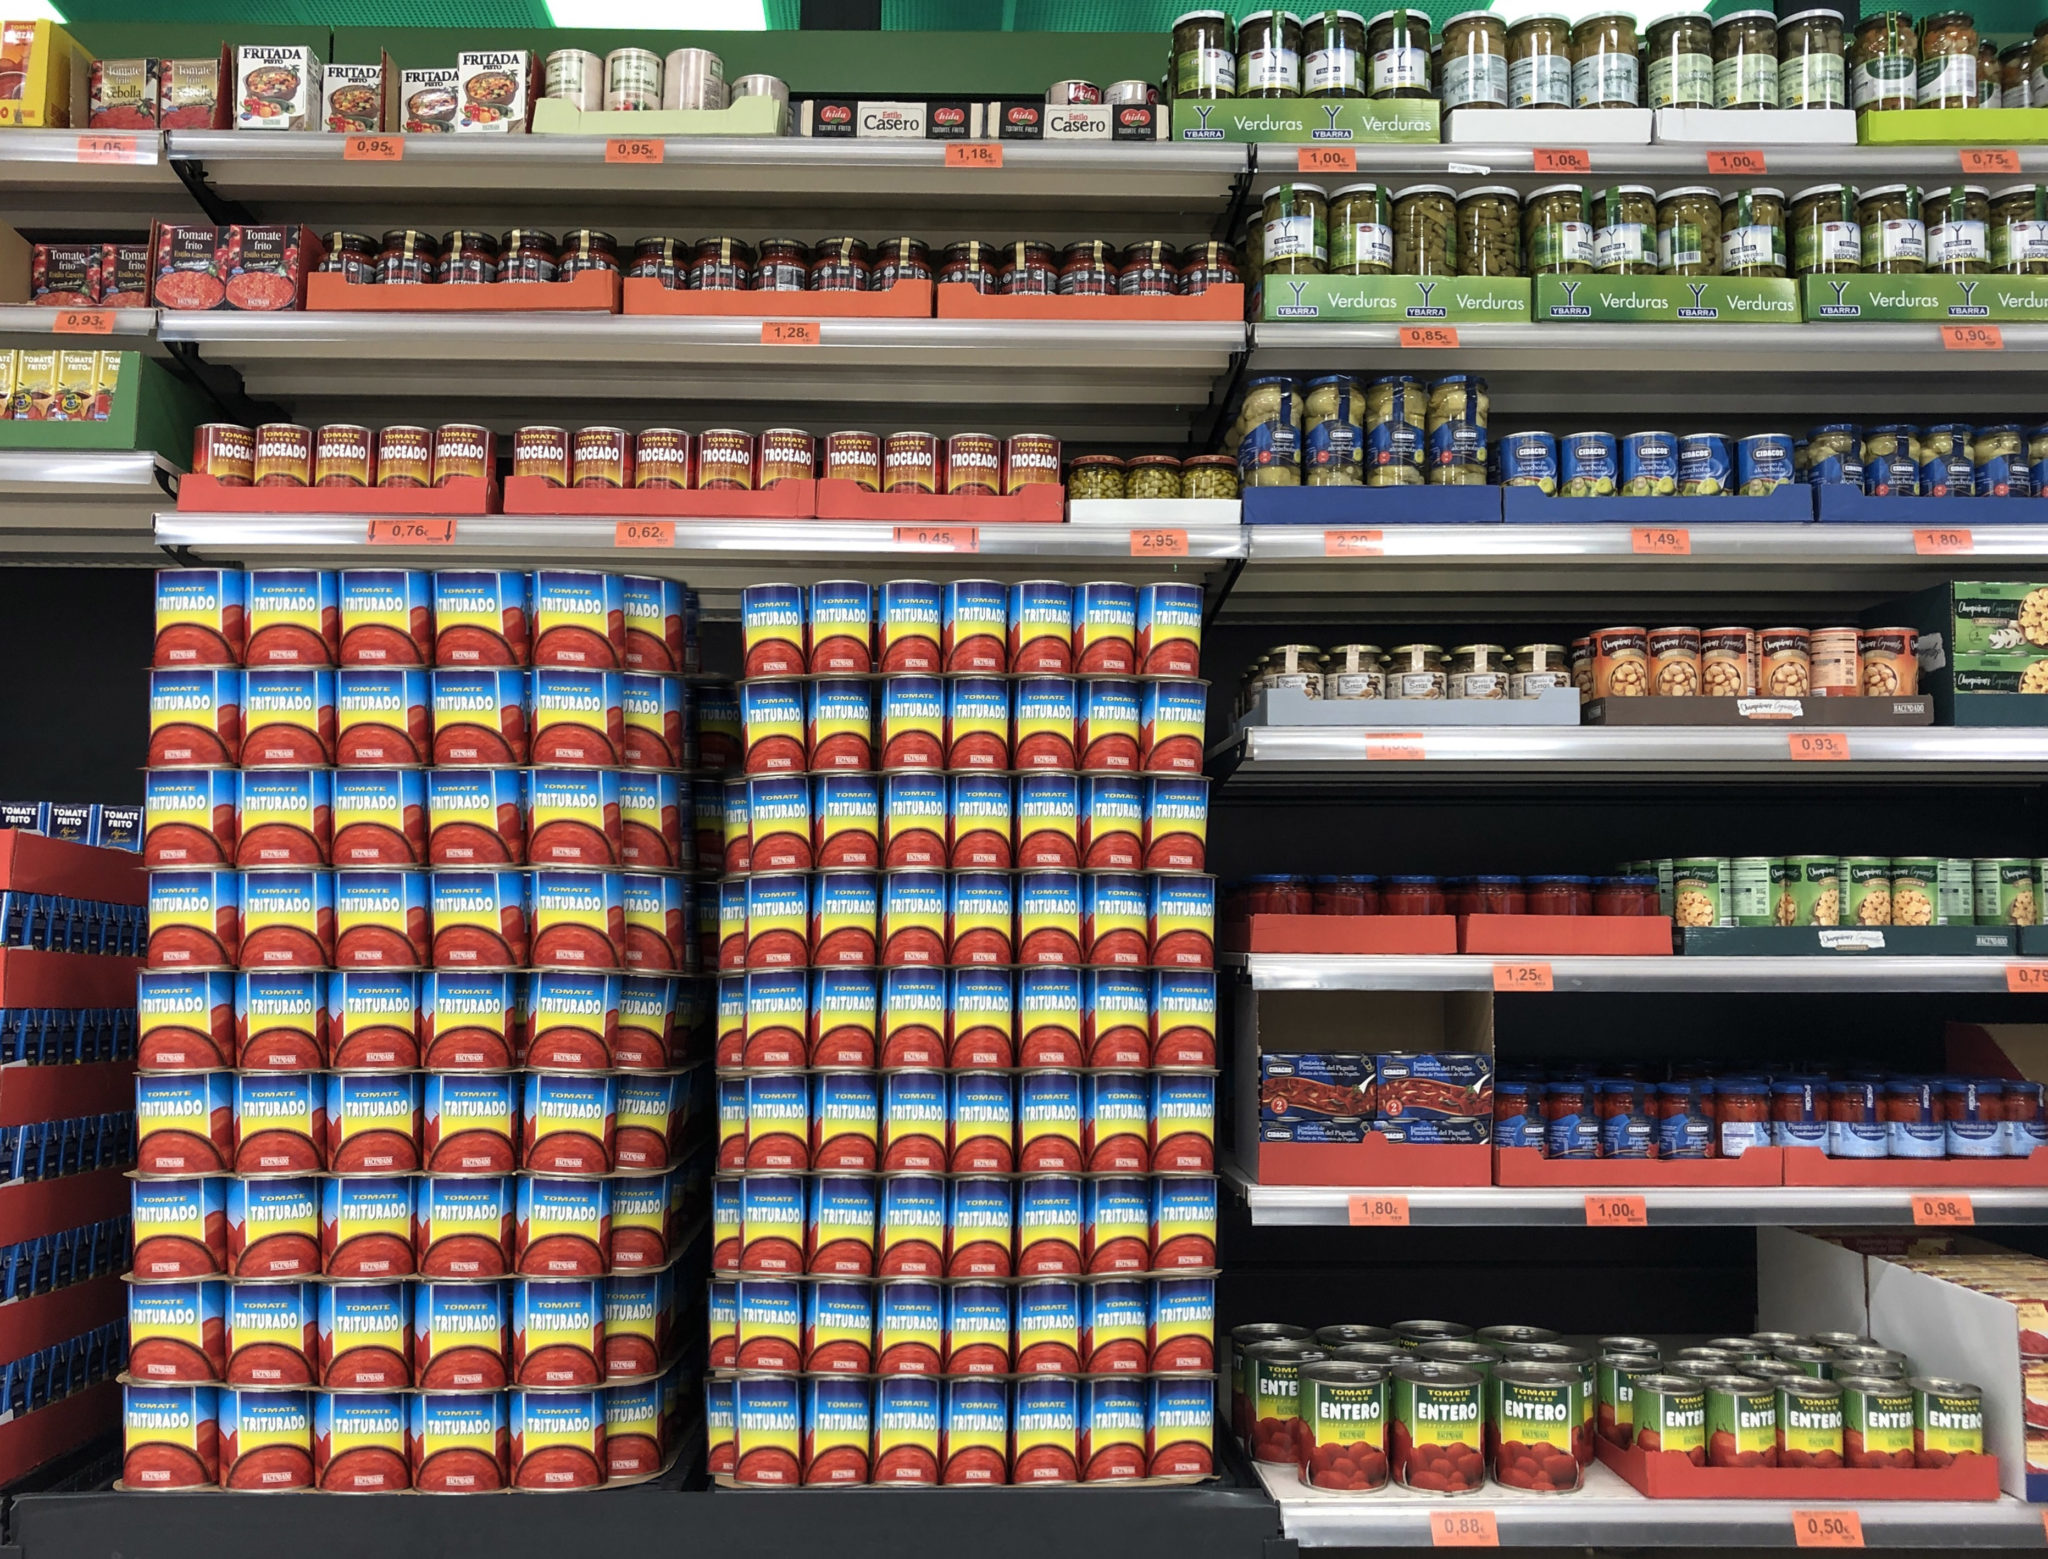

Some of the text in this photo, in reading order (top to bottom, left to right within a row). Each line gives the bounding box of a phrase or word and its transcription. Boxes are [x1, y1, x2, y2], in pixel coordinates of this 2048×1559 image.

[243, 47, 302, 60] FRITADA
[463, 54, 520, 66] FRITADA
[405, 71, 459, 83] FRITADA
[824, 109, 847, 120] hida
[882, 110, 902, 119] Estilo
[938, 111, 960, 121] hida
[1012, 111, 1034, 121] hida
[1068, 112, 1088, 121] Estilo
[818, 124, 851, 132] TOMATE FRITO
[864, 115, 919, 131] Casero
[1050, 117, 1106, 133] Casero
[1234, 114, 1303, 132] Verduras
[1362, 115, 1431, 133] Verduras
[932, 126, 965, 134] TOMATE FRITO
[1186, 130, 1222, 139] YBARRA
[1315, 130, 1350, 139] YBARRA
[357, 140, 394, 153] 0,95€
[618, 143, 654, 156] 0,95€
[958, 148, 993, 162] 1,18€
[1310, 152, 1346, 165] 1,00€
[1546, 153, 1581, 168] 1,08€
[1972, 154, 2008, 168] 0,75€
[1719, 156, 1756, 170] 1,00€
[177, 228, 213, 241] Tomate
[246, 228, 282, 241] Tomate
[185, 240, 203, 252] frito
[254, 240, 272, 252] frito
[51, 249, 85, 261] Tomate
[59, 260, 75, 271] frito
[1328, 291, 1397, 309] Verduras
[1456, 293, 1525, 310] Verduras
[1600, 292, 1669, 309] Verduras
[1727, 294, 1794, 312] Verduras
[1869, 290, 1939, 308] Verduras
[1998, 291, 2048, 308] Verdur
[1279, 308, 1316, 316] YBARRA
[1408, 308, 1445, 317] YBARRA
[1552, 307, 1588, 316] YBARRA
[1680, 309, 1715, 318] YBARRA
[1821, 307, 1857, 316] YBARRA
[1950, 307, 1986, 316] YBARRA
[67, 315, 104, 327] 0,93€
[774, 327, 809, 339] 1,28€
[1411, 331, 1448, 343] 0,85€
[1955, 330, 1991, 343] 0,90€
[65, 355, 94, 364] TOMATE
[68, 363, 89, 371] FRITO
[263, 431, 301, 439] TOMATE
[520, 433, 557, 442] TOMATE
[770, 436, 807, 445] TOMATE
[259, 443, 306, 460] TROCEADO
[437, 443, 484, 460] TROCEADO
[1016, 441, 1054, 450] TOMATE
[1518, 447, 1546, 456] CIDACOS
[1579, 447, 1606, 456] CIDACOS
[1640, 447, 1669, 457] CIDACOS
[517, 445, 563, 462] TROCEADO
[765, 448, 811, 466] TROCEADO
[1755, 449, 1784, 458] CIDACOS
[1011, 453, 1058, 470] TROCEADO
[392, 525, 428, 538] 0,76€
[628, 526, 664, 539] 0,62€
[1142, 534, 1178, 548] 2,95€
[1644, 533, 1680, 546] 1,49€
[1927, 533, 1963, 546] 1,80€
[548, 588, 592, 596] TOMATE
[159, 595, 216, 613] TRITURADO
[541, 596, 602, 615] TRITURADO
[754, 601, 791, 609] TOMATE
[748, 612, 798, 628] TRITURADO
[1156, 610, 1201, 628] TRITURADO
[820, 704, 870, 721] TRITURADO
[1801, 737, 1839, 752] 0,93€
[899, 790, 936, 798] TOMATE
[148, 795, 206, 812] TRITURADO
[893, 800, 943, 818] TRITURADO
[1, 806, 37, 816] TOMATE
[53, 806, 88, 819] TOMATE
[104, 810, 139, 821] TOMATE
[5, 815, 31, 825] FRITO
[57, 816, 82, 827] FRITO
[108, 818, 133, 829] FRITO
[249, 896, 311, 914] TRITURADO
[1025, 898, 1077, 916] TRITURADO
[1506, 968, 1541, 982] 1,25€
[2019, 969, 2048, 984] 0,79
[142, 996, 204, 1015] TRITURADO
[348, 997, 410, 1015] TRITURADO
[891, 994, 942, 1013] TRITURADO
[1032, 1093, 1070, 1101] TOMATE
[1025, 1104, 1077, 1122] TRITURADO
[1275, 1102, 1283, 1111] 2
[1390, 1102, 1398, 1112] 2
[435, 1204, 497, 1222] TRITURADO
[1163, 1205, 1215, 1222] TRITURADO
[1361, 1202, 1399, 1217] 1,80€
[1598, 1203, 1634, 1218] 1,00€
[1923, 1202, 1961, 1218] 0,98€
[346, 1304, 391, 1312] TOMATE
[337, 1314, 399, 1333] TRITURADO
[887, 1314, 939, 1332] TRITURADO
[1260, 1378, 1298, 1398] ENTE
[1329, 1387, 1374, 1397] TOMATE
[1427, 1388, 1471, 1398] TOMATE
[1513, 1387, 1558, 1397] TOMATE
[1797, 1397, 1840, 1406] TOMATE
[1937, 1397, 1981, 1406] TOMATE
[536, 1407, 582, 1416] TOMATE
[1320, 1401, 1379, 1422] ENTERO
[1418, 1401, 1477, 1422] ENTERO
[1505, 1400, 1567, 1422] ENTERO
[528, 1416, 590, 1434] TRITURADO
[742, 1412, 796, 1431] TRITURADO
[1790, 1410, 1842, 1429] ENTERO
[1868, 1410, 1912, 1429] ENTER
[1445, 1519, 1485, 1536] 0,88€
[1808, 1518, 1849, 1535] 0,50€
